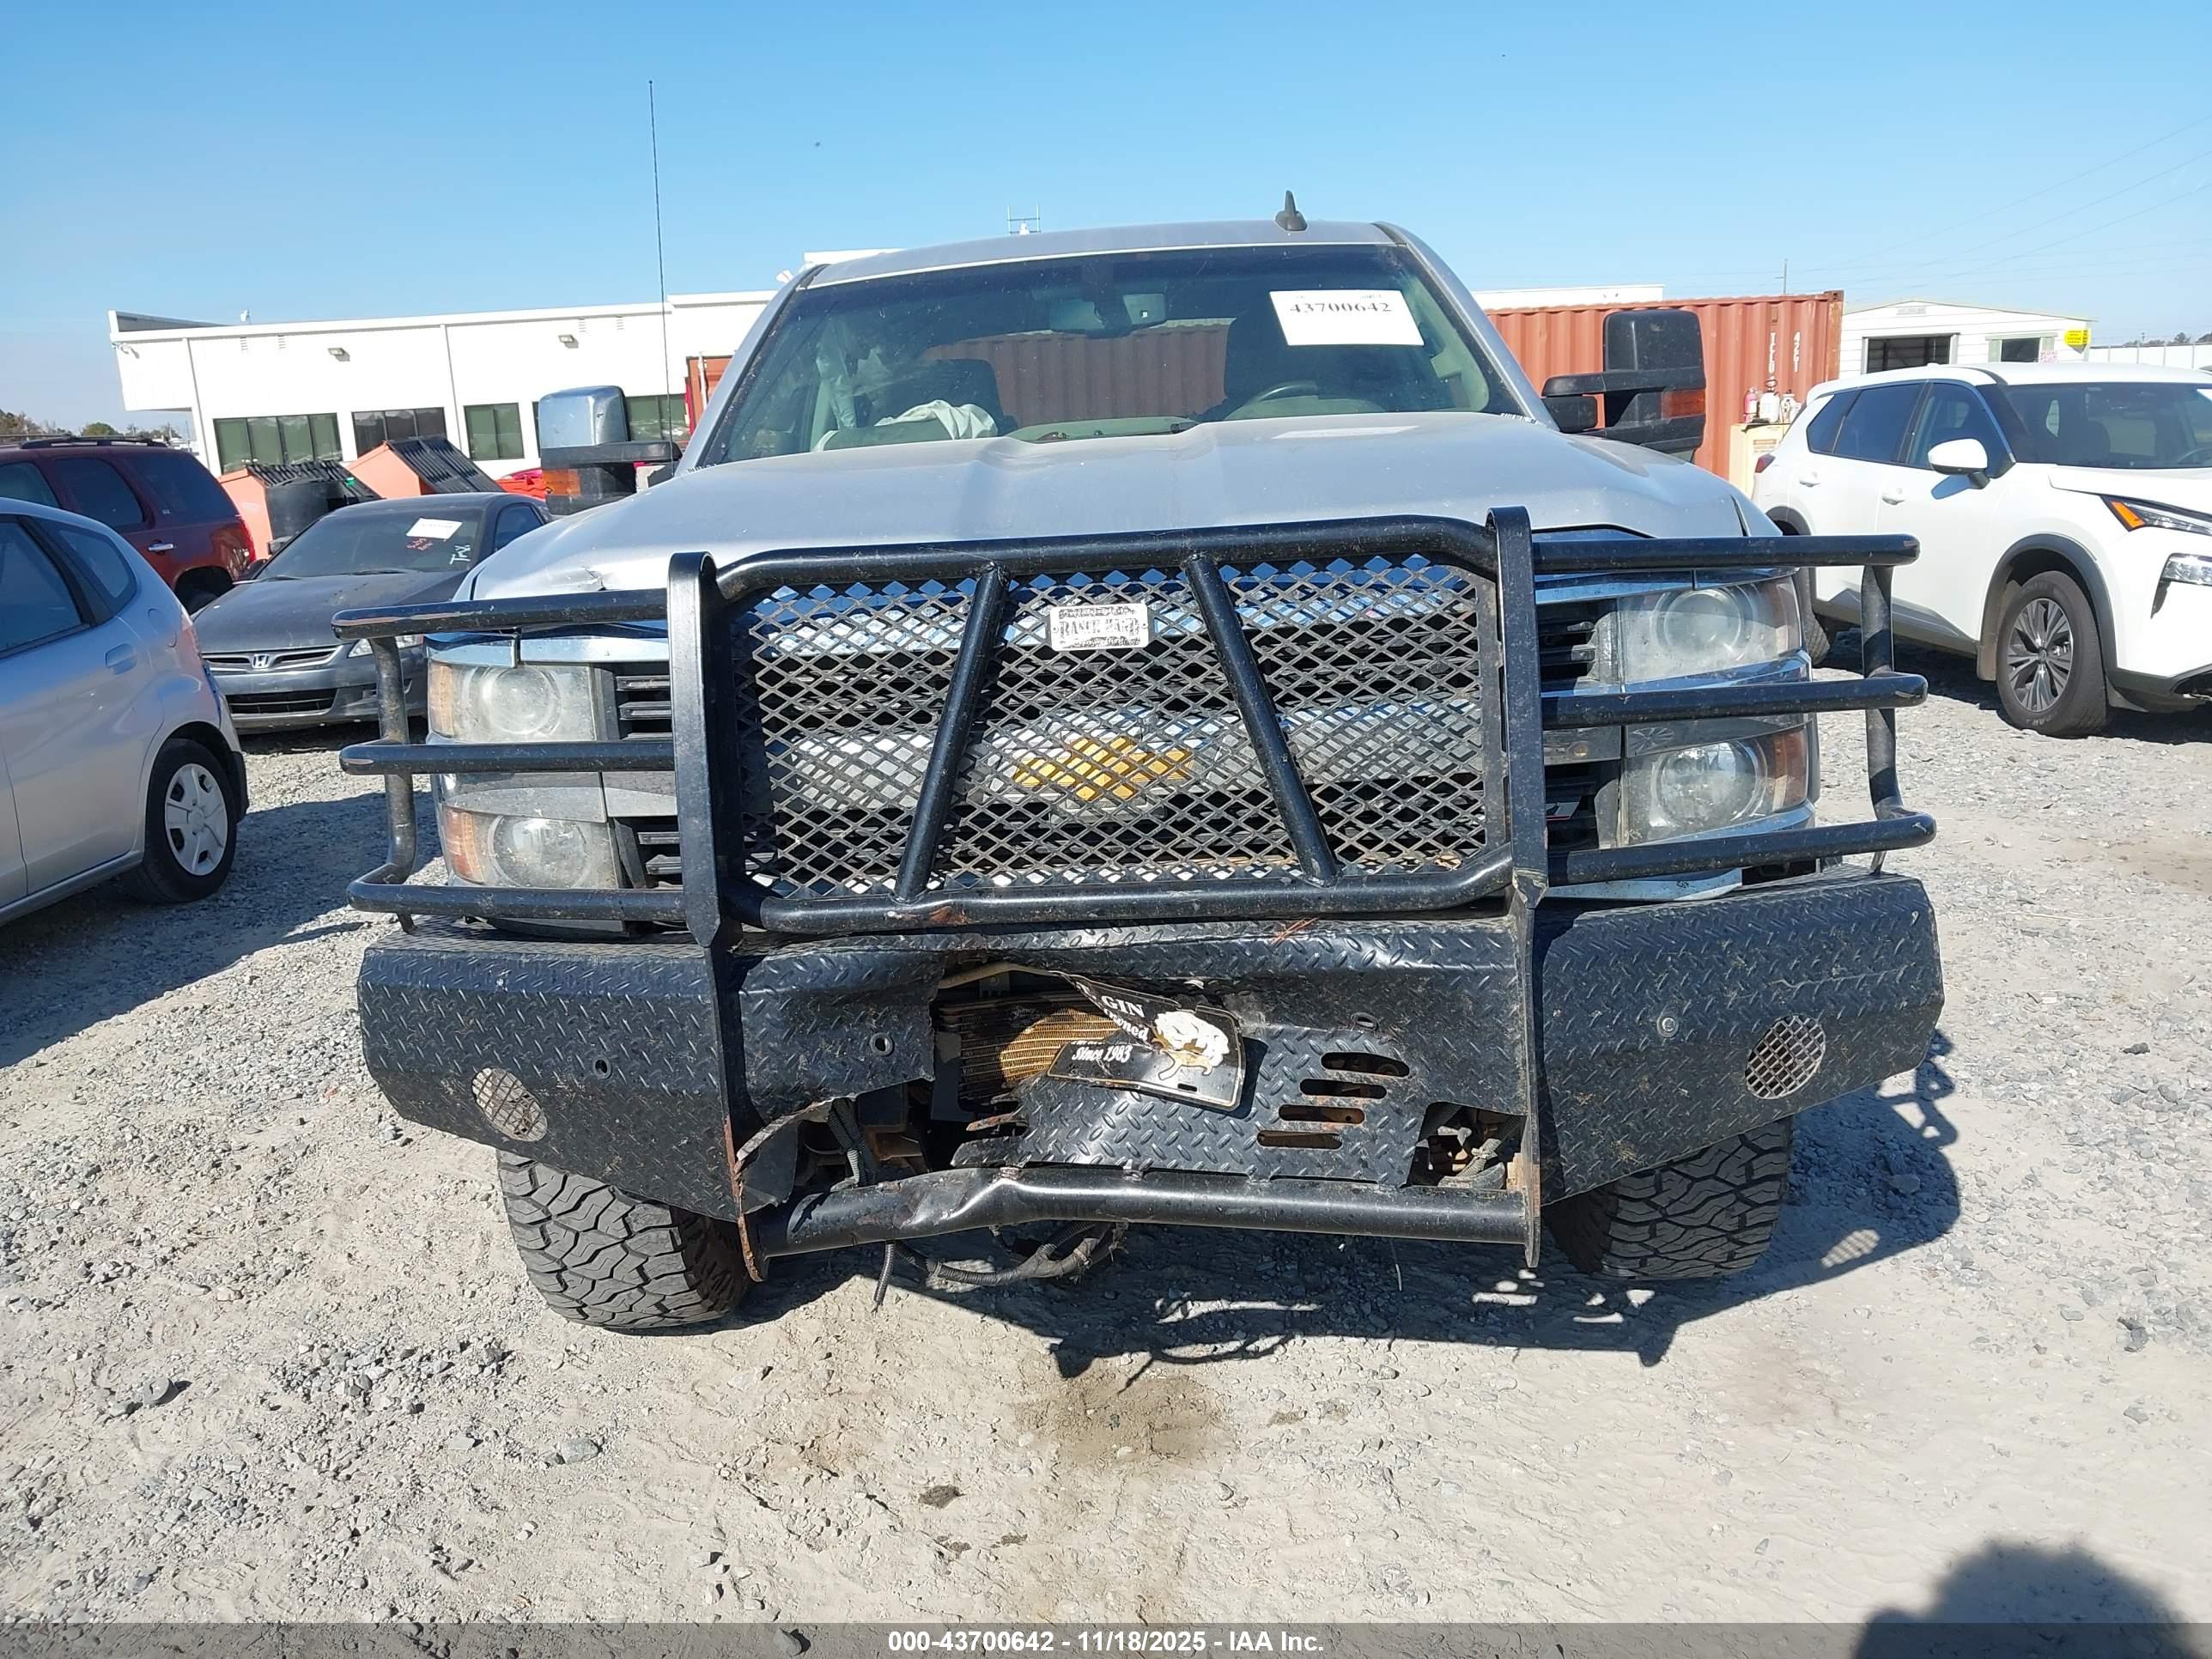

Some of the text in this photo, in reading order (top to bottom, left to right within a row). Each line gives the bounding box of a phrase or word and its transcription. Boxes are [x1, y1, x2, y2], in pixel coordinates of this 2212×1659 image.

[1290, 302, 1392, 313] 43700642
[1101, 995, 1146, 1018] GIN
[1071, 1044, 1133, 1063] Since 1983
